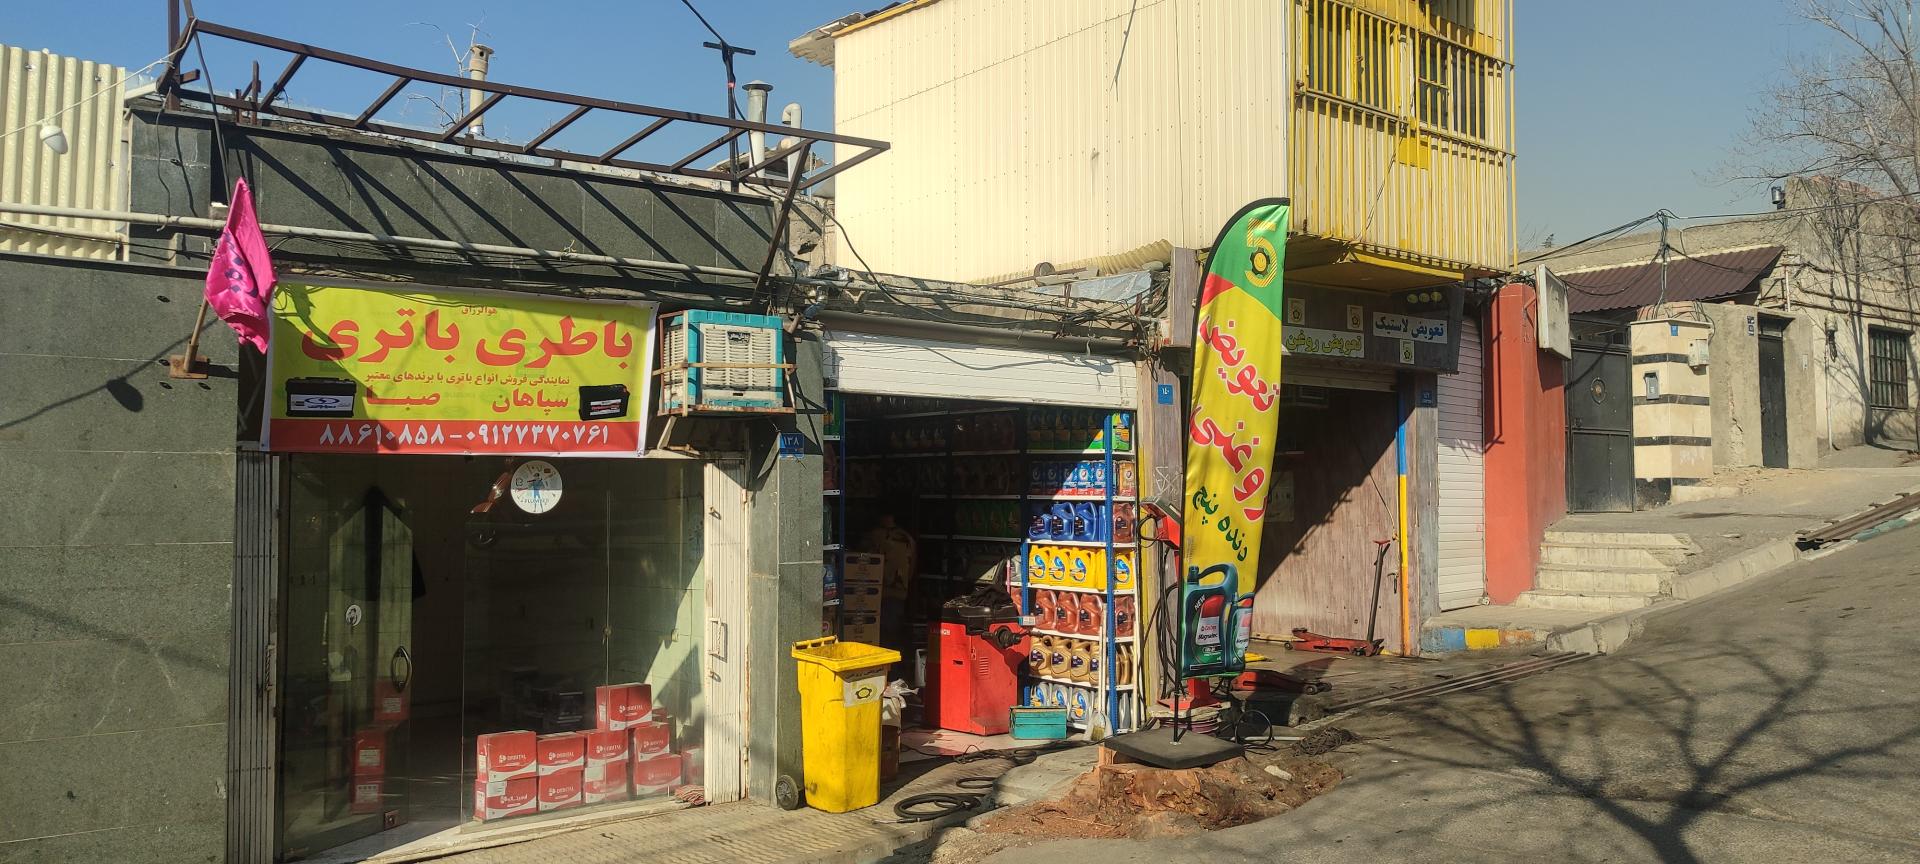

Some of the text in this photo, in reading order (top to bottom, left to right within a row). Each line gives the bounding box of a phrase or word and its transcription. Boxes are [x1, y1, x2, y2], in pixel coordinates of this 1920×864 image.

[301, 308, 634, 369] باطری باتری
[1375, 316, 1445, 340] تعویض لاستیک
[1285, 329, 1362, 356] تعویض روغن
[1199, 315, 1281, 412] تعویض
[366, 371, 570, 387] نمایندگی فروش انواع باتری با برندهای معتبر
[366, 386, 569, 415] سپاهان صبا
[1192, 485, 1248, 562] دنده پنج
[1194, 594, 1206, 611] NEW
